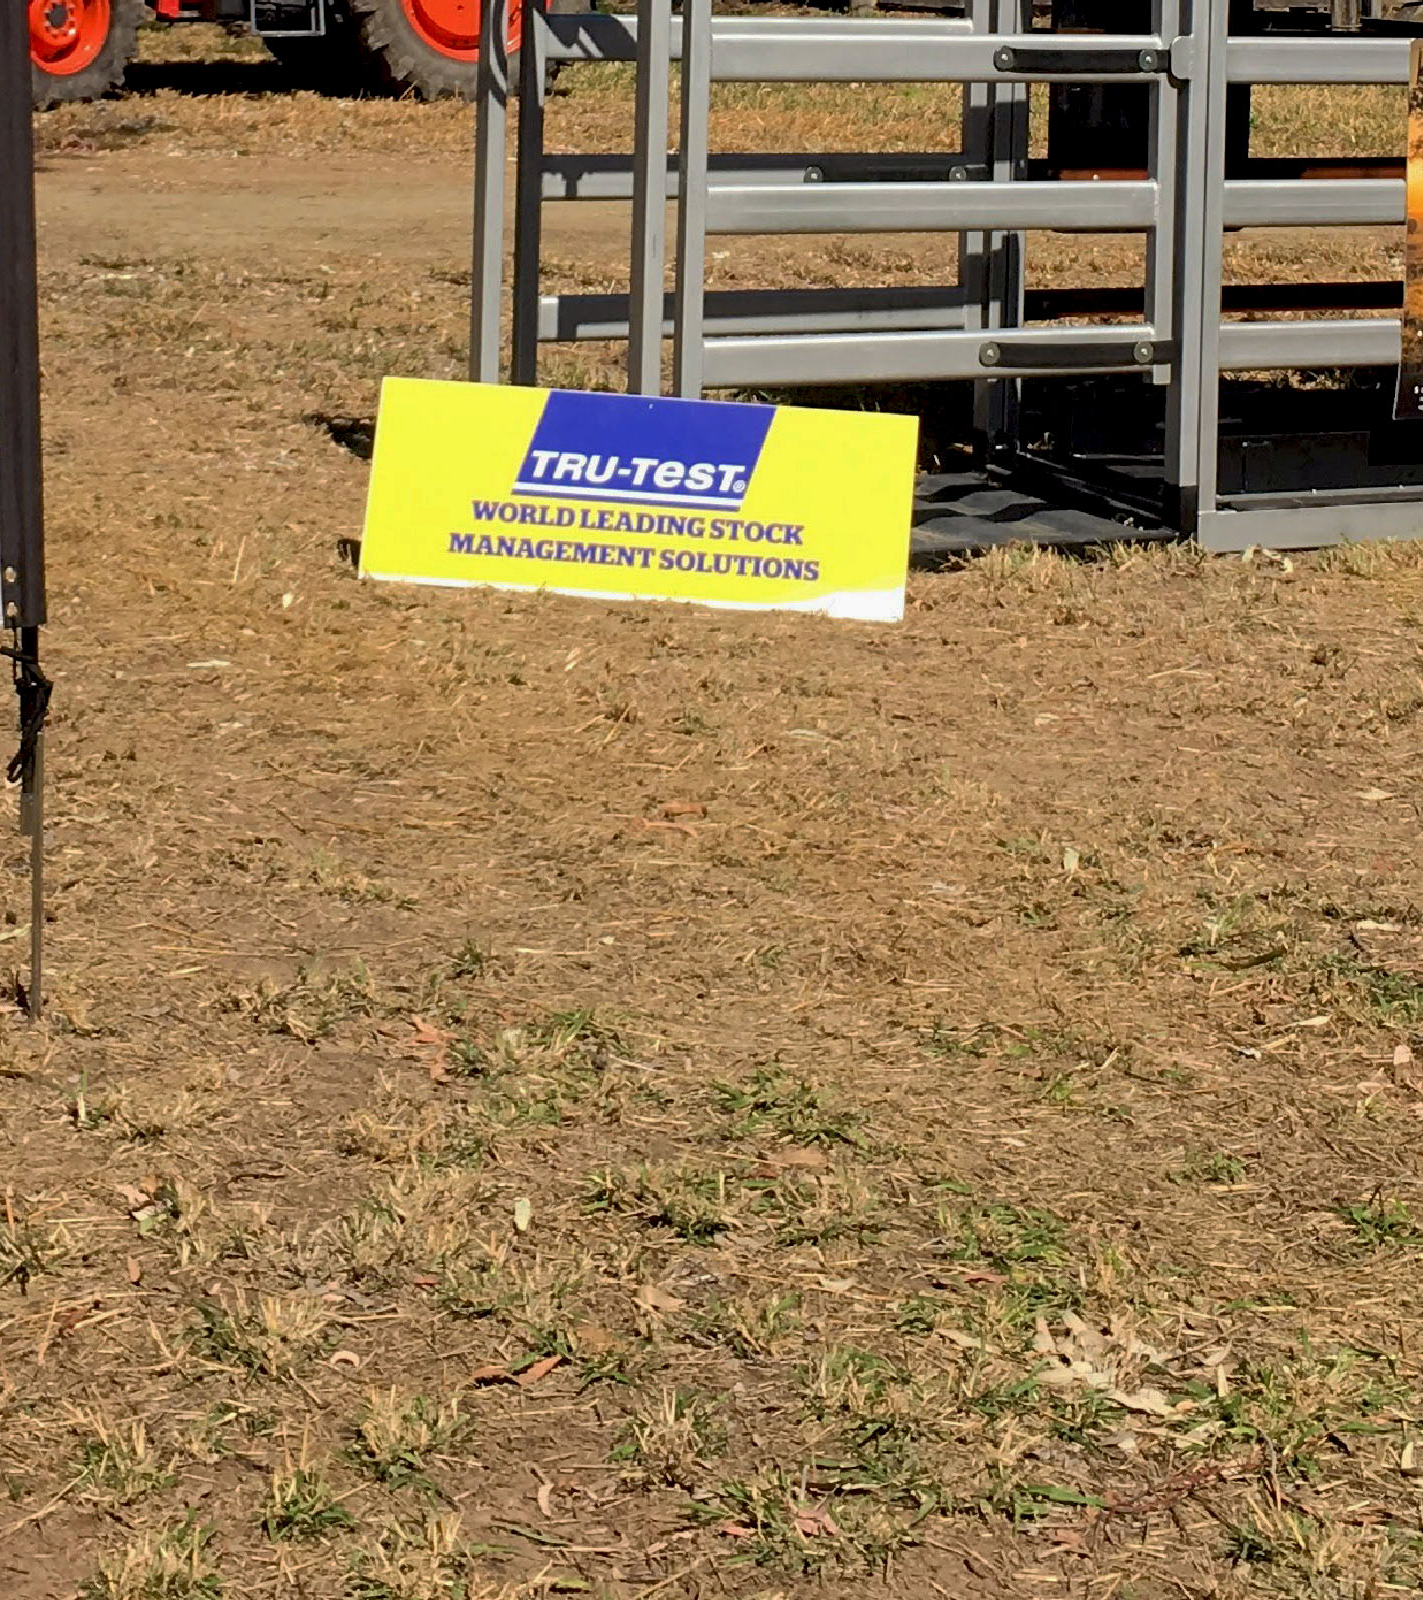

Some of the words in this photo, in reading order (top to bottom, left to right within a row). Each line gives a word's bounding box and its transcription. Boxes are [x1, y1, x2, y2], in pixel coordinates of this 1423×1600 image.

[471, 499, 575, 527] WORLD
[579, 508, 706, 538] LEADING
[709, 518, 805, 546] STOCK
[448, 532, 656, 569] MANAGEMENT
[658, 548, 821, 582] SOLUTIONS
